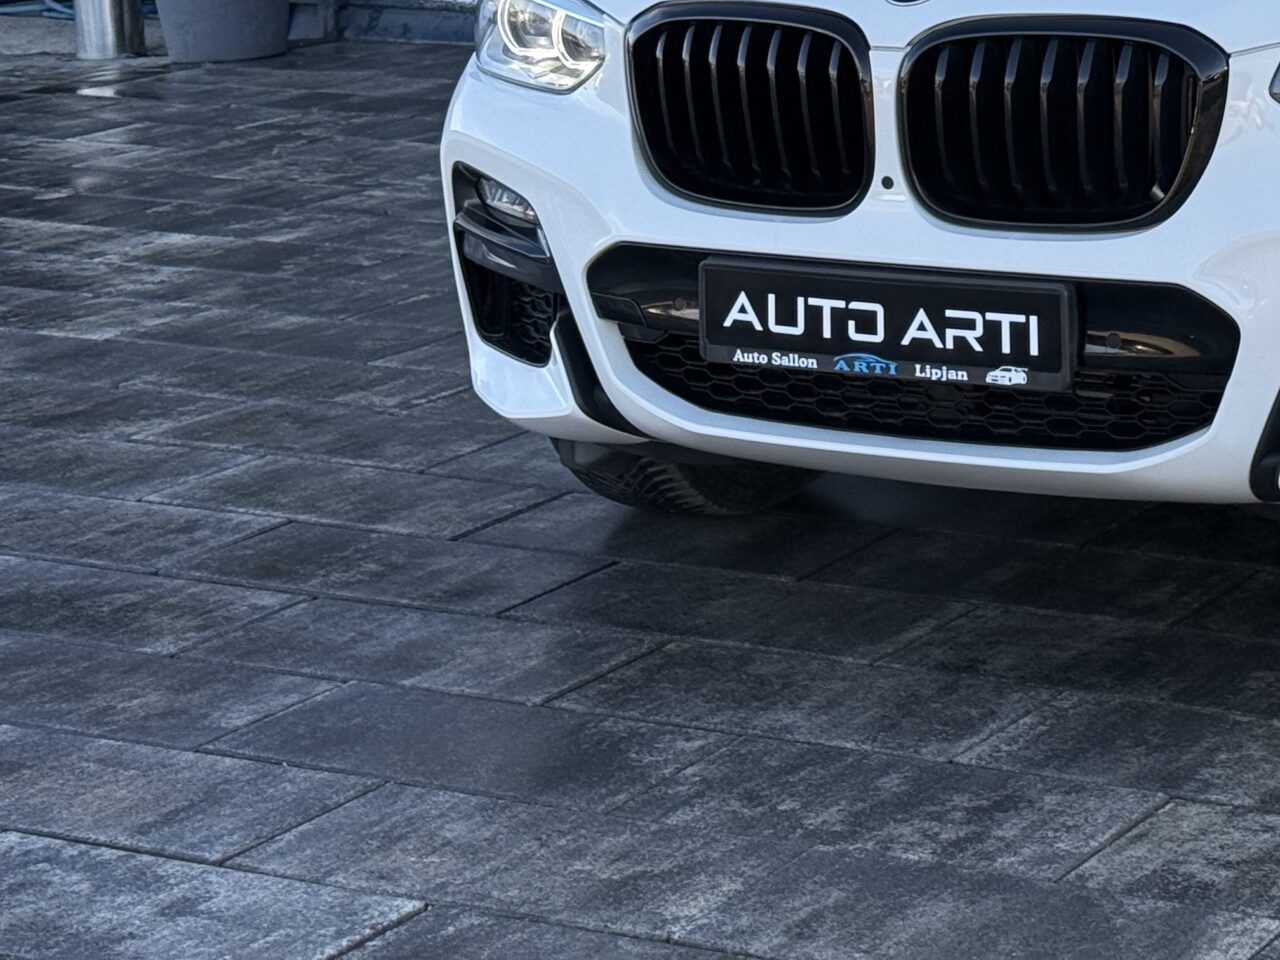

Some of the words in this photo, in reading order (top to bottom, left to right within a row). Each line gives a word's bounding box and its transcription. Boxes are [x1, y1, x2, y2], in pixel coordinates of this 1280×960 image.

[722, 290, 885, 343] AUTO
[900, 307, 1039, 357] ARTI
[732, 348, 769, 365] Auto
[771, 351, 819, 369] Sallon
[833, 359, 897, 375] ARTI
[914, 363, 969, 382] Lipjan
